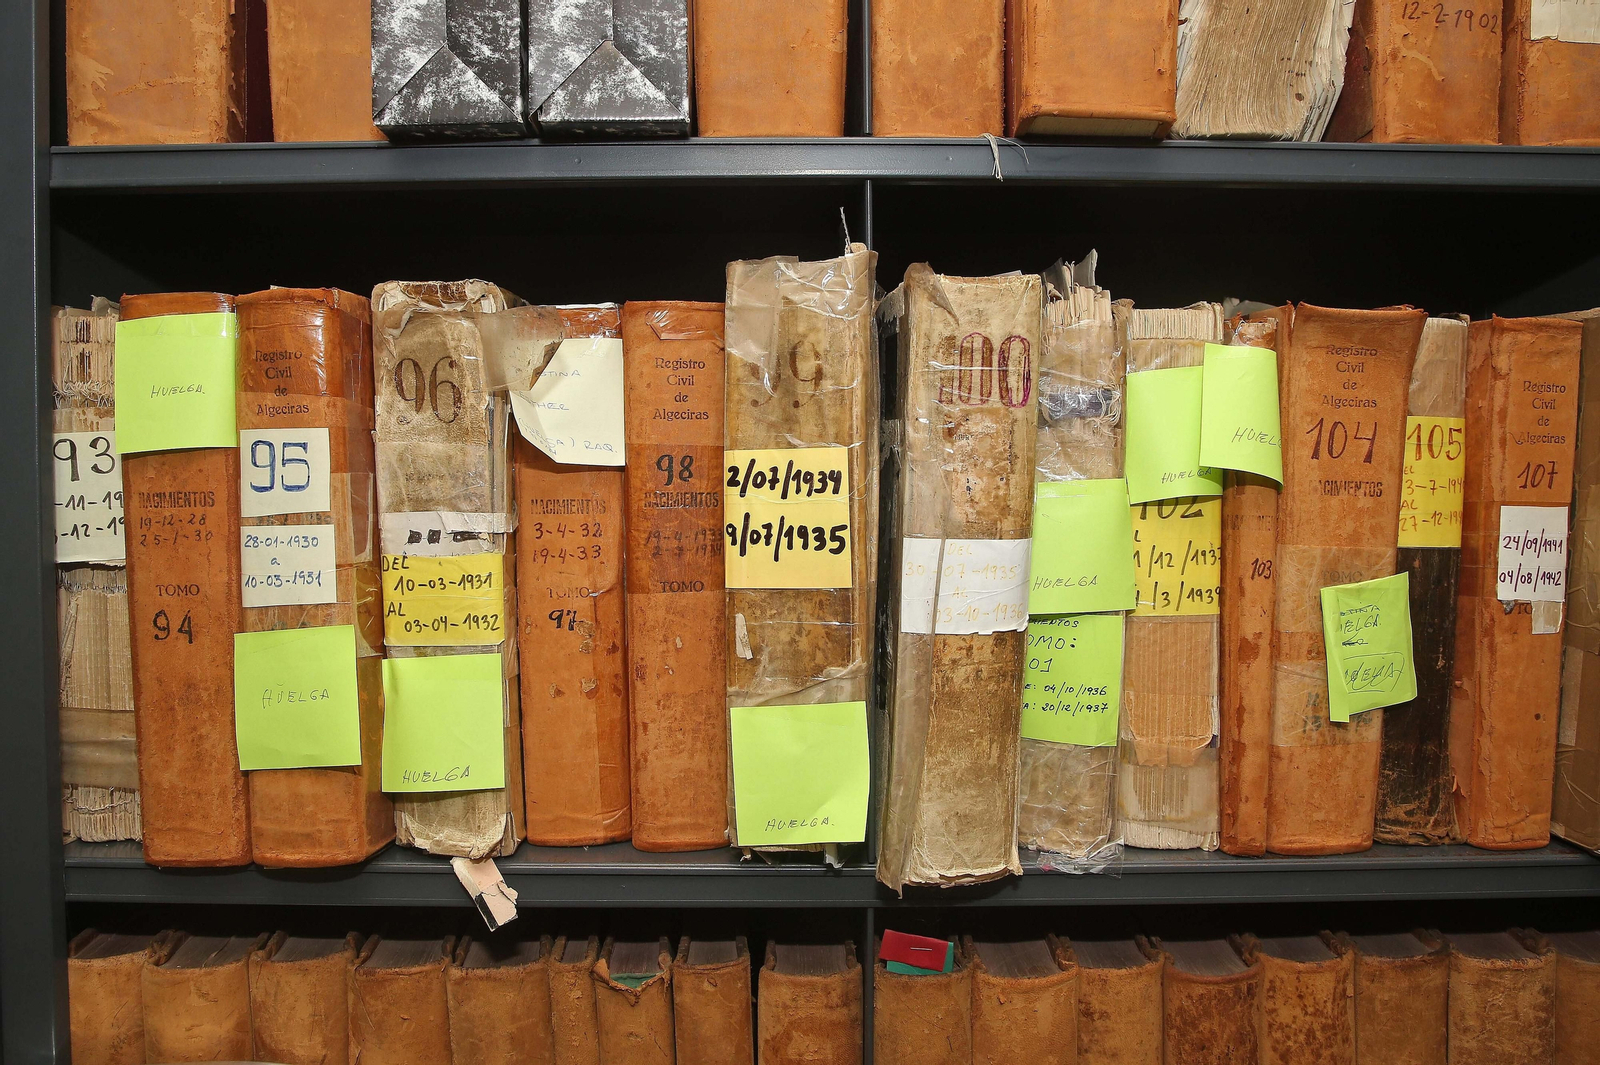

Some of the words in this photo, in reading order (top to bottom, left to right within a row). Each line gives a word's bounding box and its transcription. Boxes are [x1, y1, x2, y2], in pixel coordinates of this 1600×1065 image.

[255, 350, 302, 363] Registro
[1326, 344, 1378, 357] Registro
[654, 357, 706, 370] Registro
[1336, 361, 1365, 373] Civil
[265, 366, 292, 379] Civil
[666, 374, 695, 386] Civil
[274, 385, 288, 397] de
[394, 355, 462, 423] 96
[1343, 380, 1358, 390] de
[1523, 380, 1566, 394] Registro
[674, 392, 689, 403] de
[1322, 395, 1377, 409] Algeciras
[1532, 398, 1556, 410] Civil
[257, 404, 310, 418] Algeciras
[653, 409, 709, 421] Algeciras
[1537, 415, 1550, 427] de
[1306, 417, 1378, 464] 104
[1407, 423, 1462, 460] 105
[1517, 431, 1566, 445] Algeciras
[53, 437, 116, 482] 93
[250, 440, 310, 493] 95
[656, 454, 694, 486] 98
[1161, 467, 1212, 484] HUELGA
[1517, 461, 1558, 489] 107
[727, 459, 843, 499] 2/07/1934
[530, 498, 606, 515] NACIMIENTOS
[643, 491, 720, 508] NACIMIENTOS
[1400, 499, 1418, 511] AL
[533, 522, 603, 539] 3-4-32
[725, 512, 848, 562] 9/07/1935
[244, 534, 319, 549] 28-01-1930
[1502, 528, 1563, 558] 24/09/1941
[270, 557, 281, 566] a
[532, 544, 602, 564] 19-4-33
[382, 555, 410, 572] DEL
[1251, 558, 1273, 581] 103
[244, 570, 323, 588] 10-03-1931
[394, 572, 492, 595] 10-03-1931
[1032, 575, 1099, 591] HUELGA
[1499, 563, 1562, 592] 04/08/1942
[156, 583, 201, 597] TOMO
[659, 580, 705, 593] TOMO
[386, 602, 406, 617] AL
[153, 609, 194, 645] 94
[404, 613, 501, 633] 03-04-1932
[1043, 681, 1107, 699] 04/10/1936
[1041, 701, 1108, 717] 20/12/1937
[402, 765, 471, 785] HUELGA
